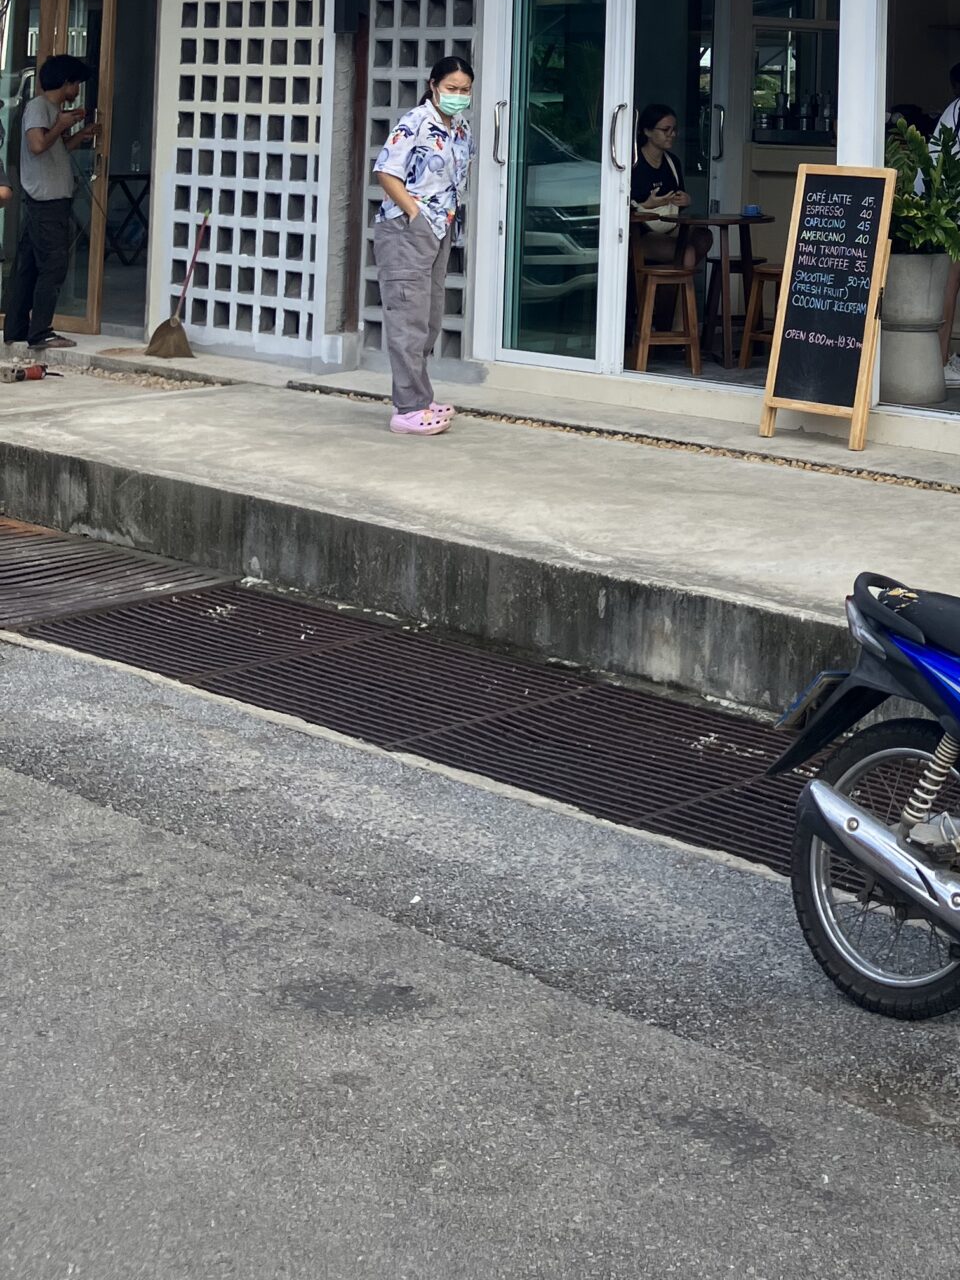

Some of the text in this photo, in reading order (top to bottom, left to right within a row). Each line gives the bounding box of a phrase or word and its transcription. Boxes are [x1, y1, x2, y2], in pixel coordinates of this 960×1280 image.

[806, 190, 826, 204] CAFÉ
[828, 193, 853, 205] LATTE
[805, 205, 844, 217] ESPRESSO
[800, 230, 846, 243] AMERICANO
[798, 243, 868, 259] THAI TRADITIONAL
[797, 255, 818, 266] MILK
[818, 257, 850, 271] COFFEE
[794, 269, 835, 285] SMOOTHIE
[791, 281, 849, 300] (FRESH FRUIT)
[792, 294, 833, 311] COCONUT
[784, 329, 806, 341] OPEN
